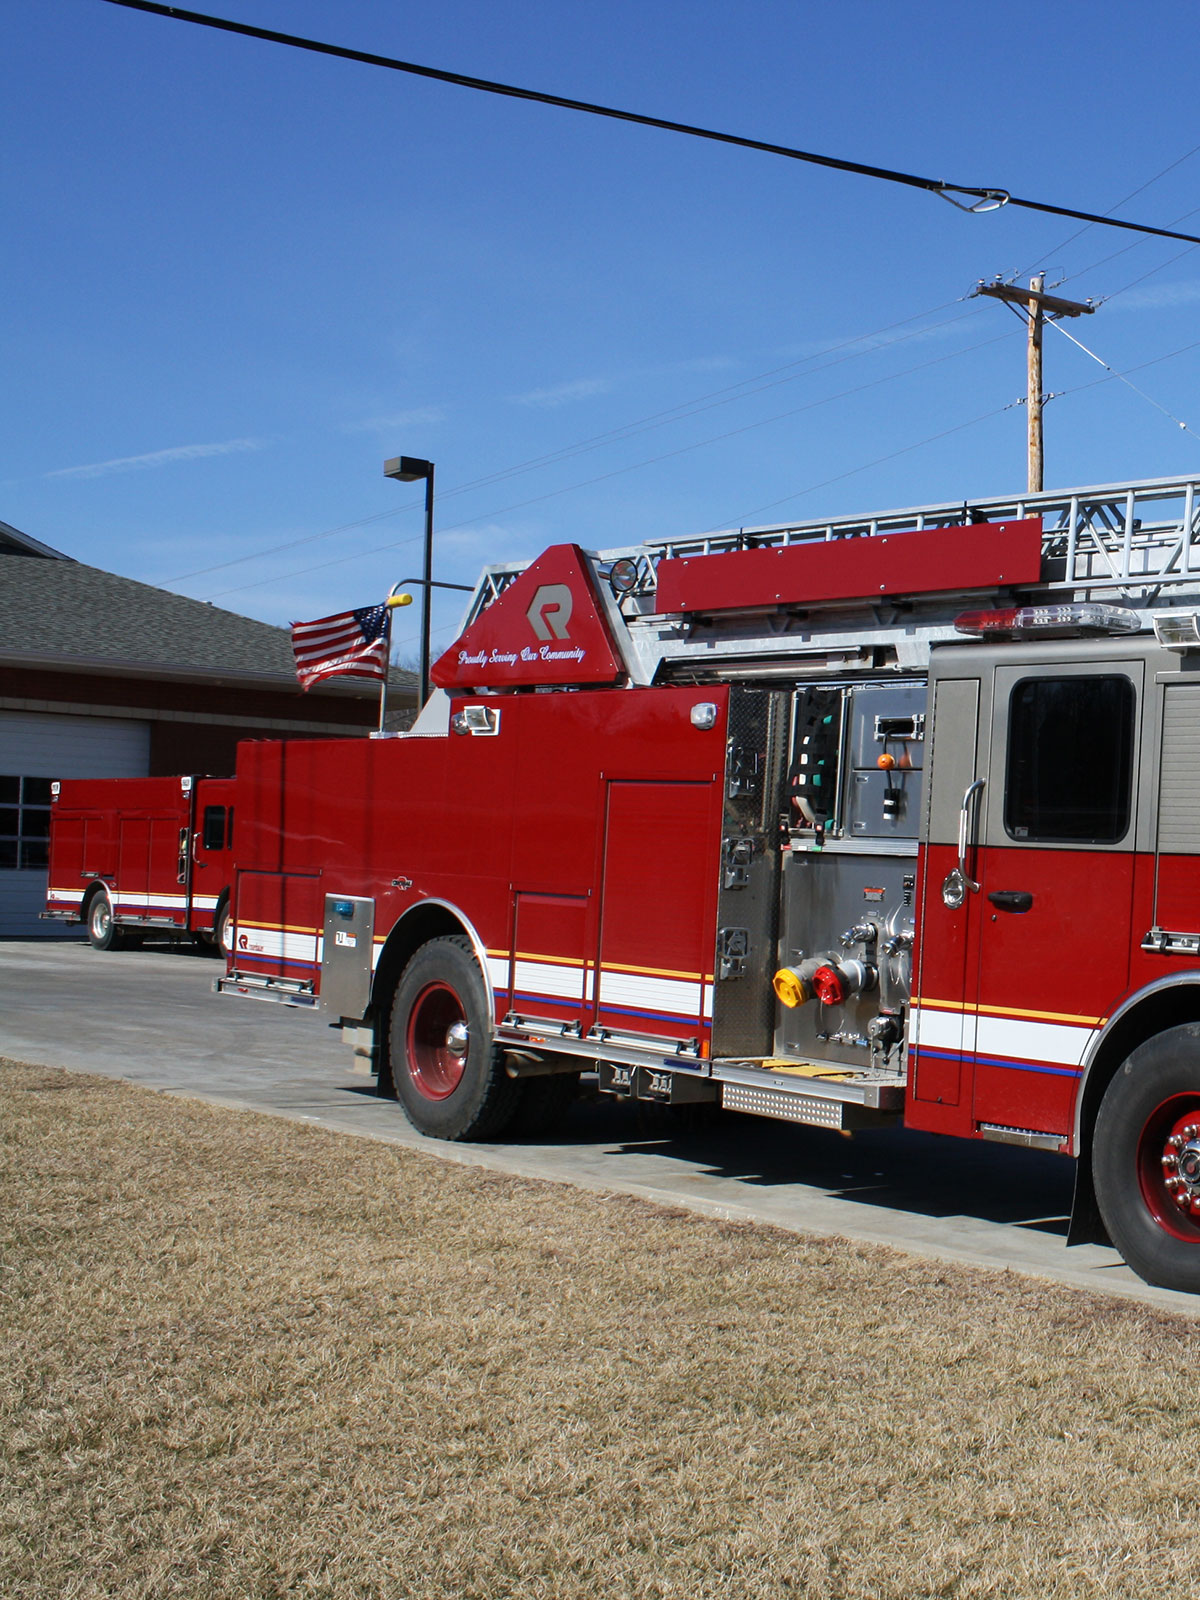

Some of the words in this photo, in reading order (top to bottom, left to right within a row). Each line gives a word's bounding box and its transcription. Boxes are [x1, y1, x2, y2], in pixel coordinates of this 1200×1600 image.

[458, 649, 488, 668] Proudly
[489, 648, 518, 667] Serving
[520, 646, 538, 661] Our
[539, 645, 586, 663] Community
